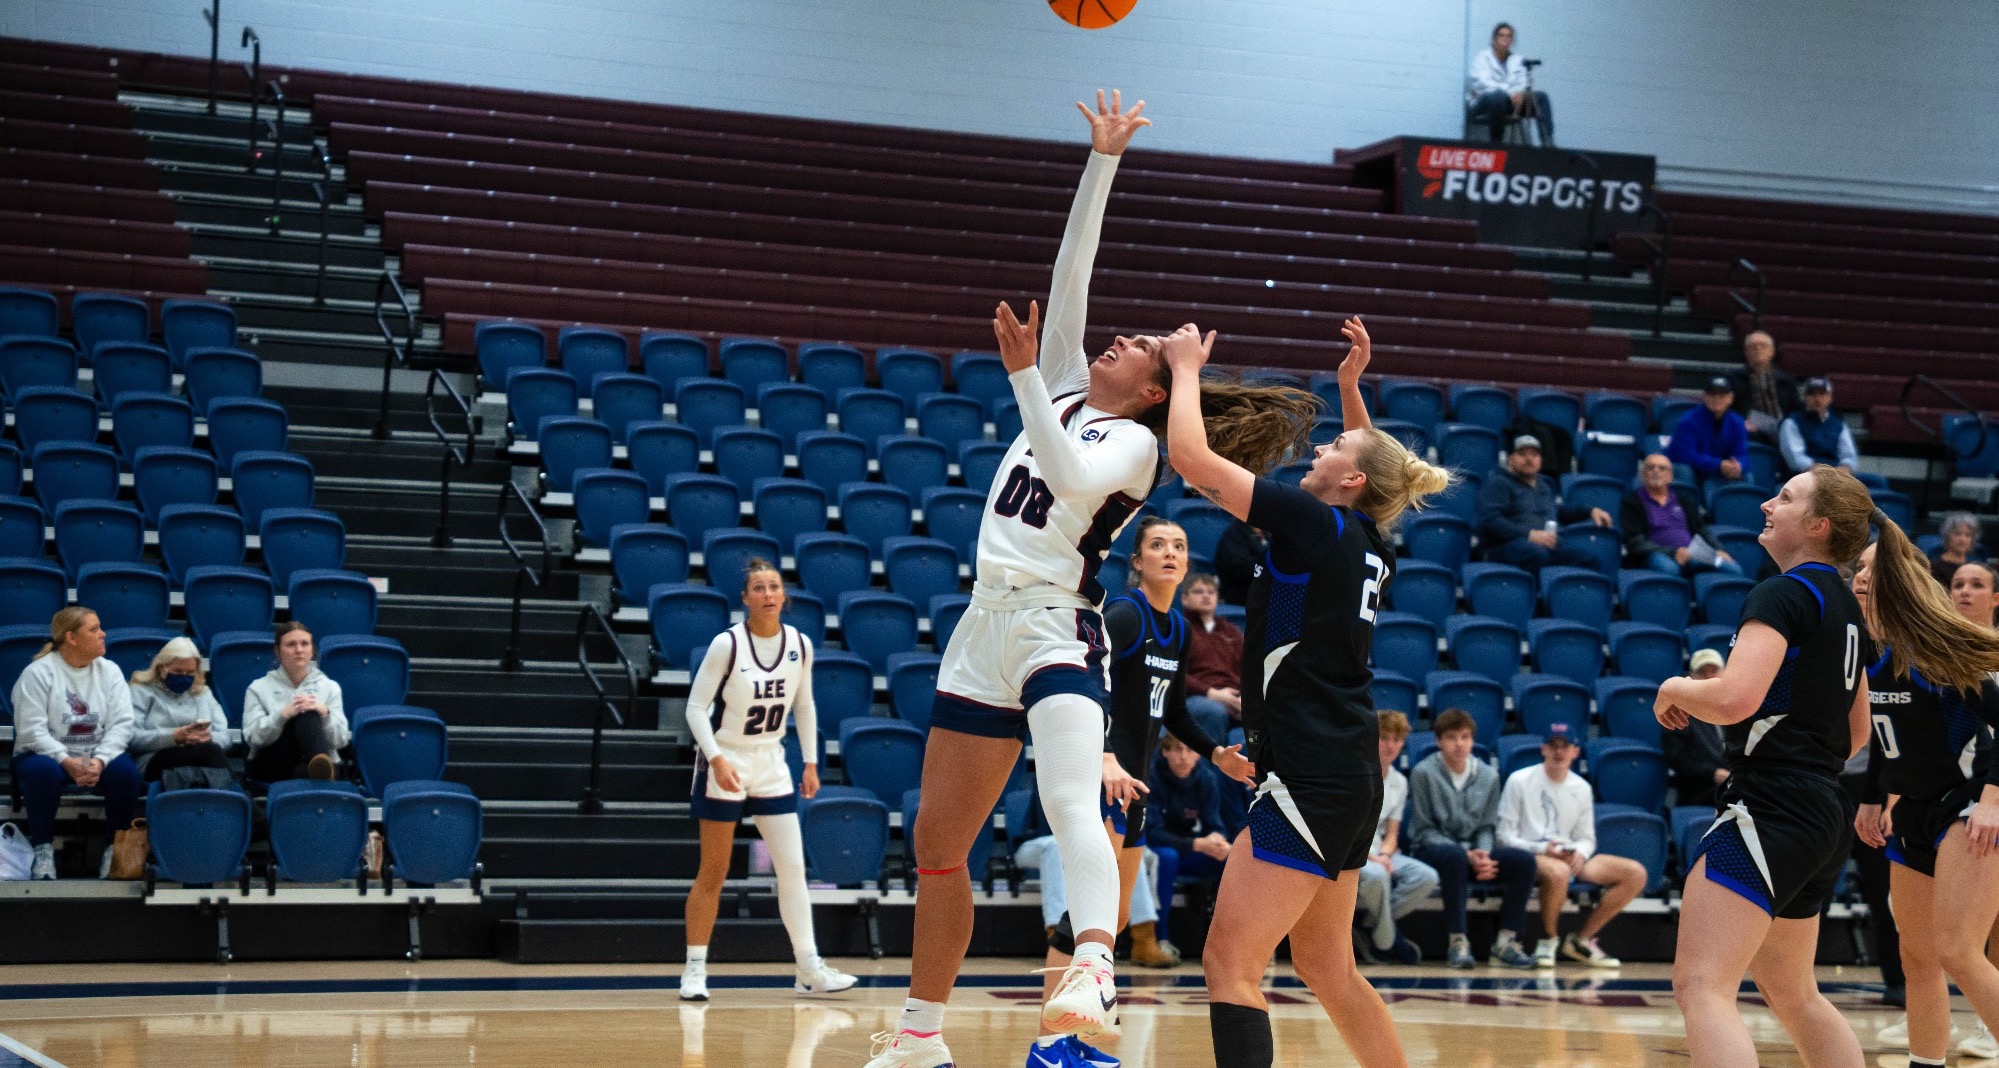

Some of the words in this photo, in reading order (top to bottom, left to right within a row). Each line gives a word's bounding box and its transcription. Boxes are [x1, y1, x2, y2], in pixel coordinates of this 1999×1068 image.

[1429, 149, 1467, 168] LIVE
[1468, 151, 1496, 169] ON
[1360, 552, 1390, 625] 2
[1844, 623, 1859, 690] 0
[753, 679, 785, 699] LEE
[743, 703, 785, 736] 20
